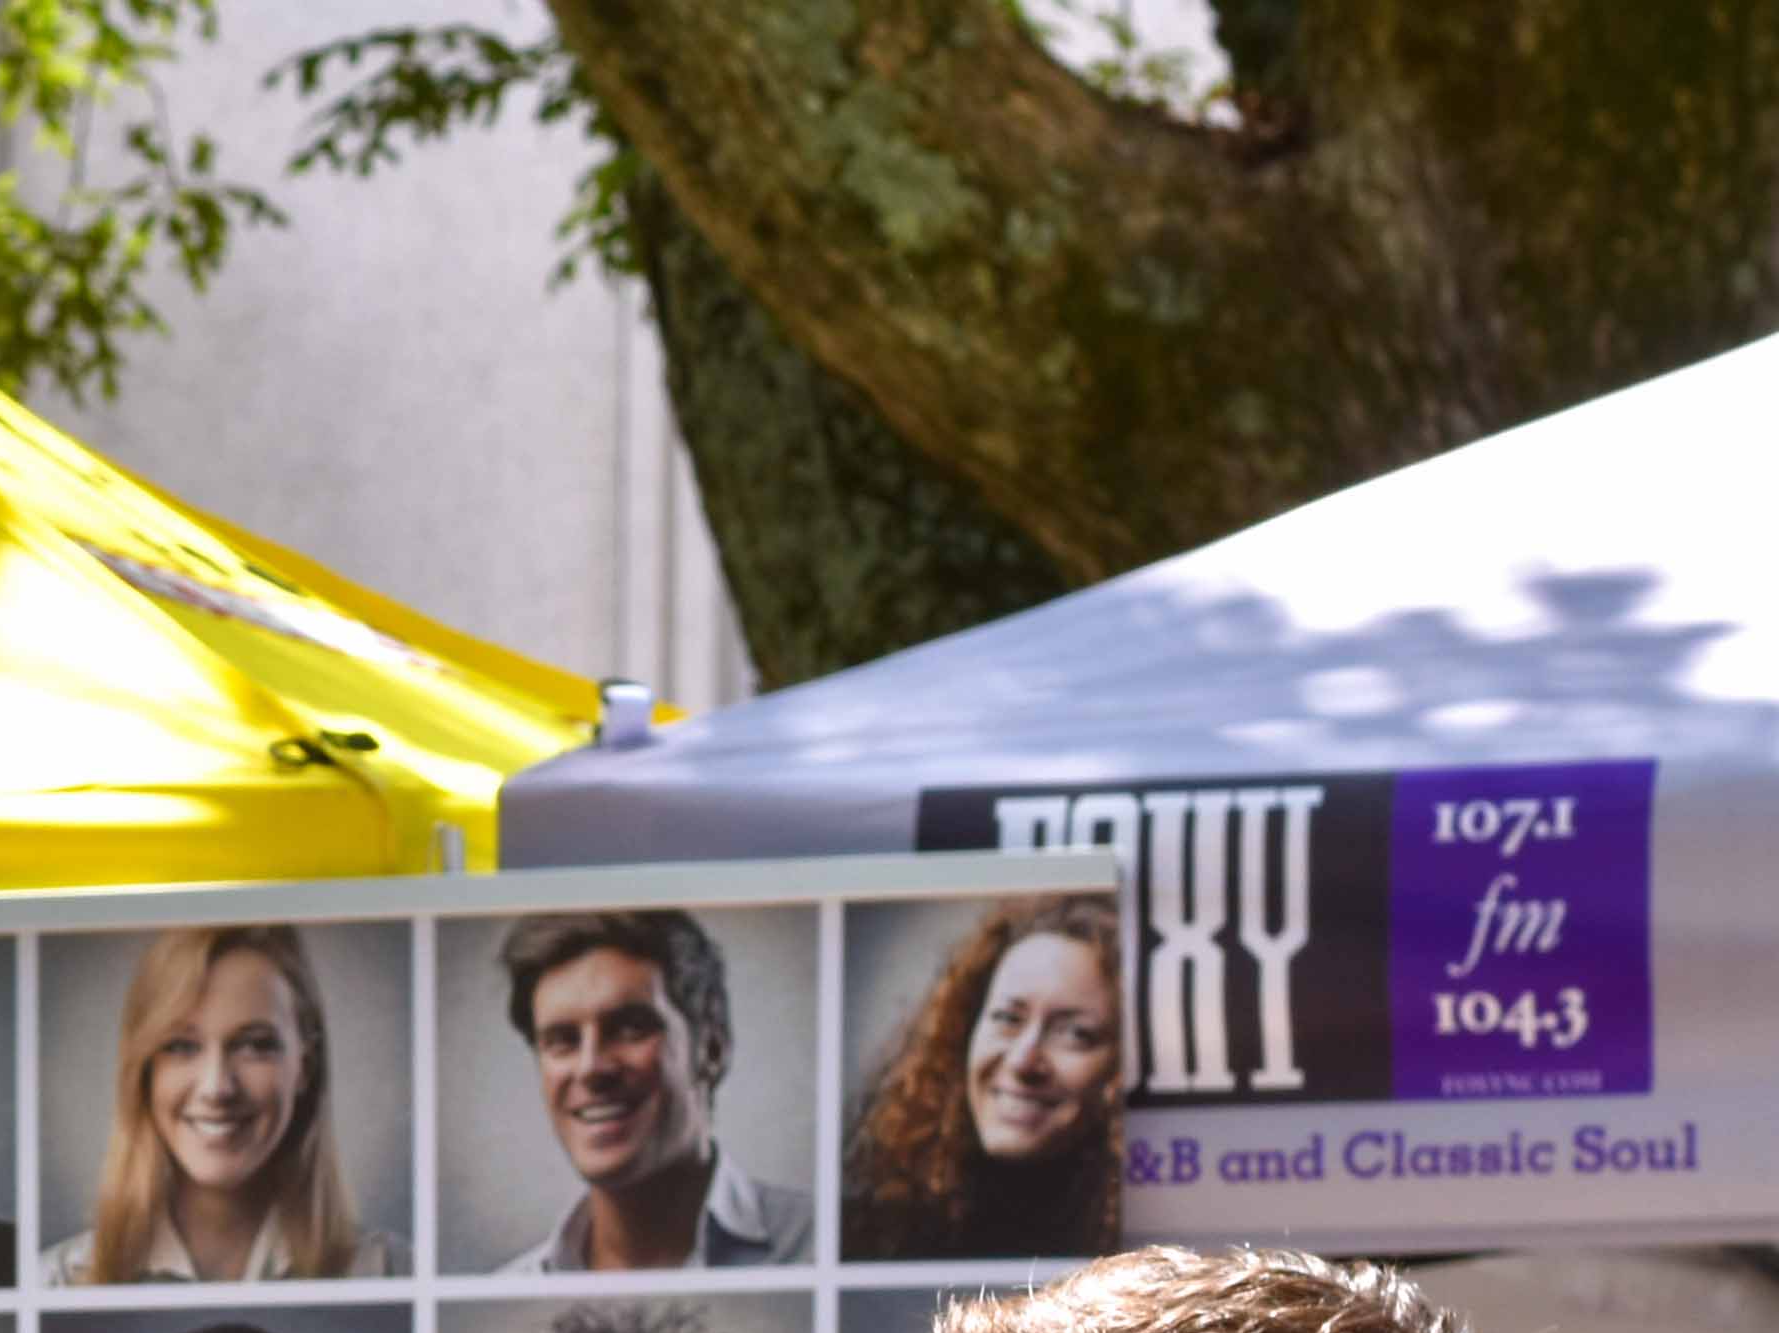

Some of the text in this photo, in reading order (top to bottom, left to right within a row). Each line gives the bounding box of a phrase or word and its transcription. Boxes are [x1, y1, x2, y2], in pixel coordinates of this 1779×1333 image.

[1433, 797, 1576, 857] 107.1
[1446, 873, 1566, 978] fm
[1434, 988, 1588, 1048] 104.3
[1218, 1132, 1324, 1184] and
[1343, 1130, 1555, 1181] Classic
[1573, 1122, 1699, 1174] Soul
